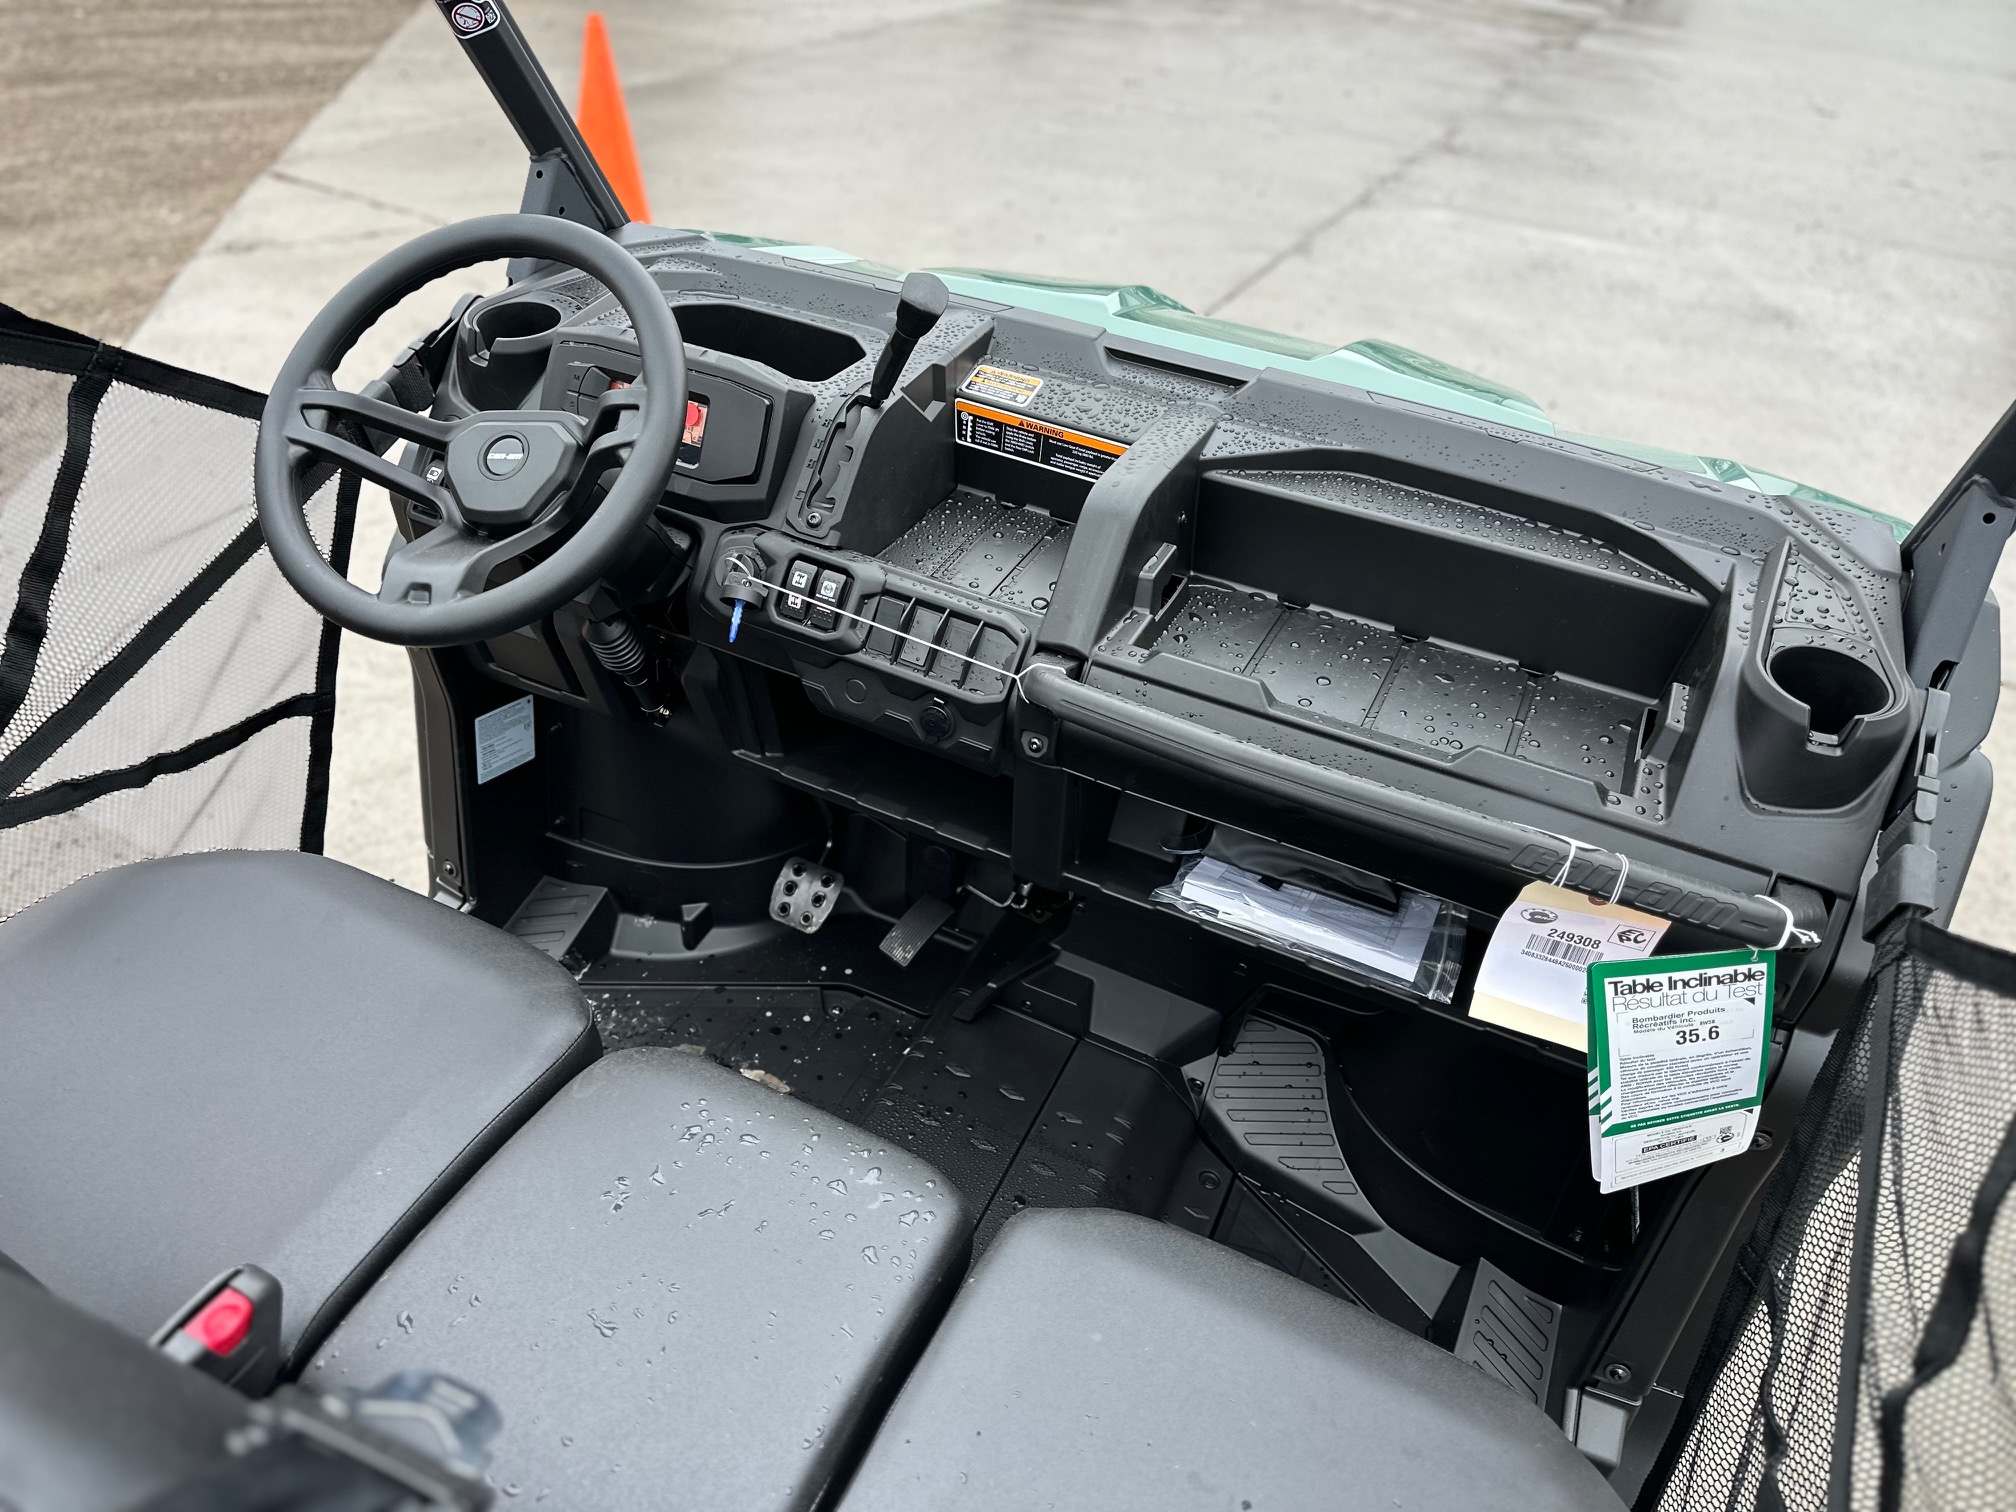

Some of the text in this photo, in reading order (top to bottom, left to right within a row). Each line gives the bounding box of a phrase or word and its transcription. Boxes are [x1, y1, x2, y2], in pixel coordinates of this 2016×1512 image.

[1026, 422, 1064, 438] WARNING
[1547, 928, 1602, 950] 249308
[1608, 978, 1663, 996] Table
[1668, 968, 1766, 991] Inclinable
[1612, 982, 1764, 1012] Résultat du Test
[1632, 1007, 1726, 1024] Bombardier Produits
[1632, 1019, 1677, 1030] Récréatifs
[1676, 1025, 1720, 1045] 35.6
